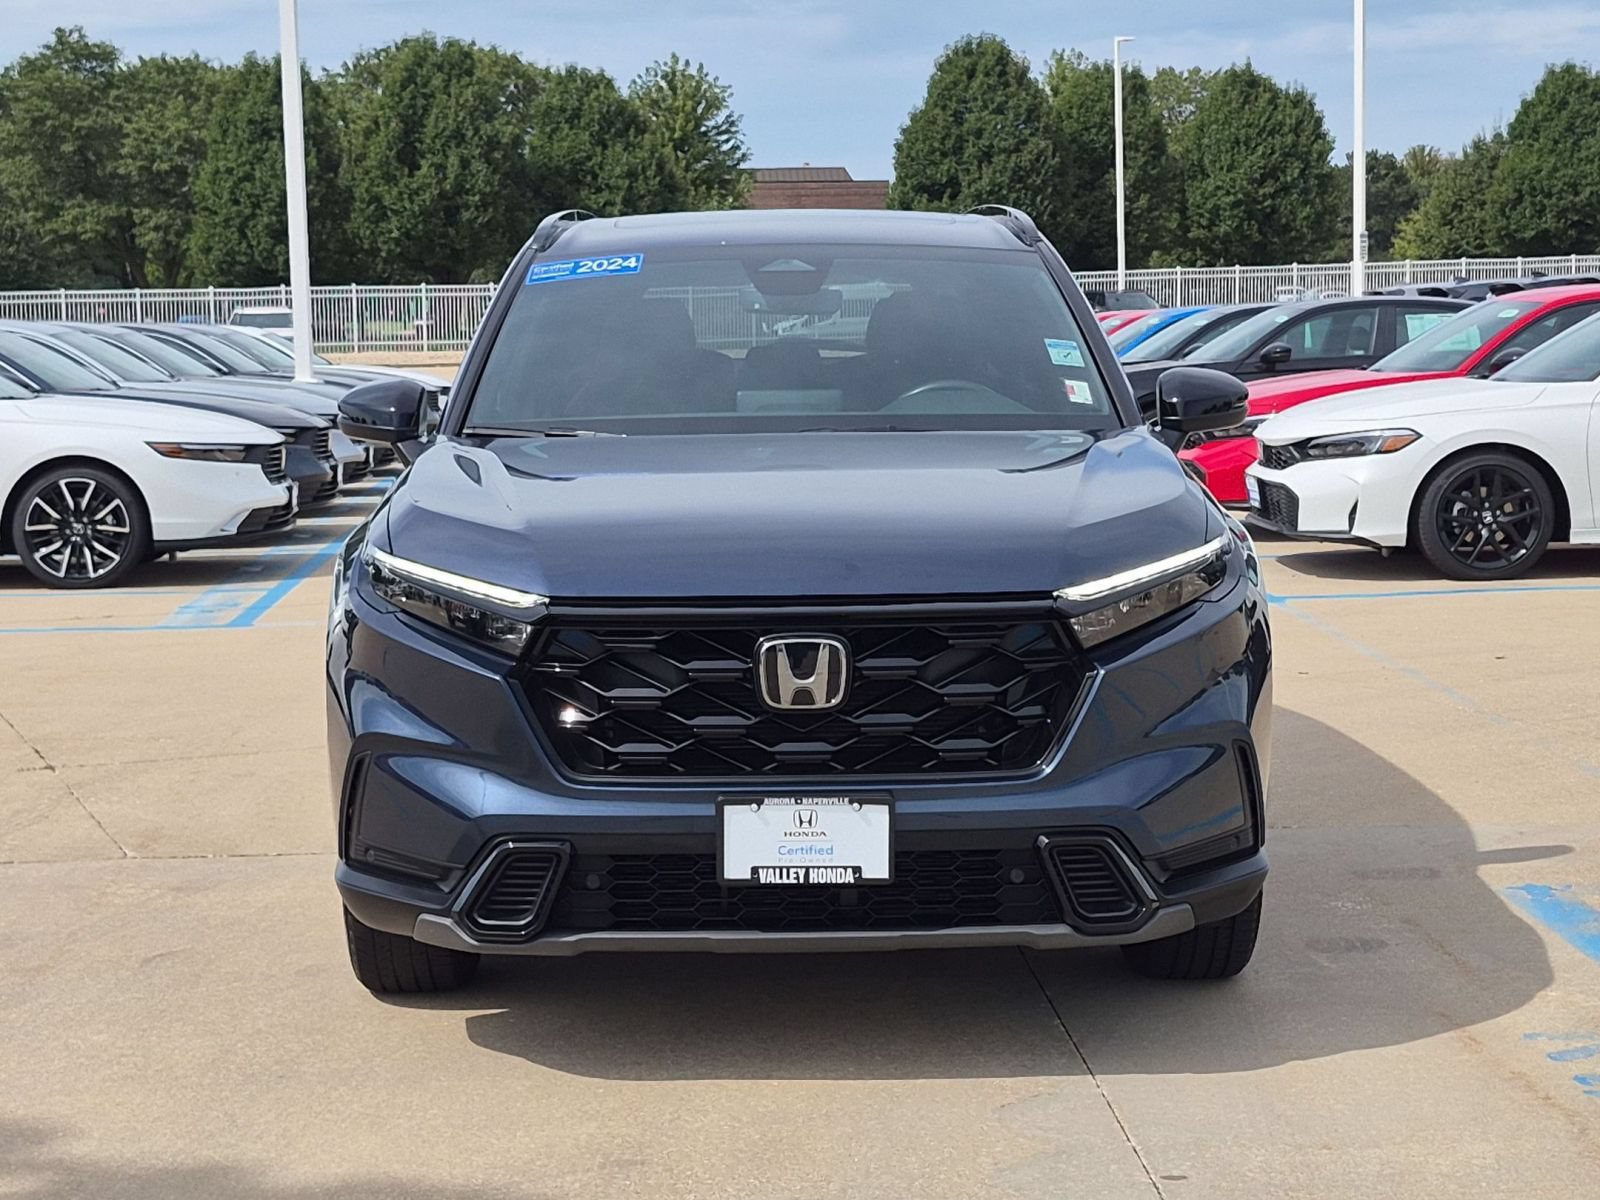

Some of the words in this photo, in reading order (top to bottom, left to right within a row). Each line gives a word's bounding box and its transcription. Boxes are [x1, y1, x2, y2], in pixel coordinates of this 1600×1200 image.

[575, 256, 638, 273] 2024
[763, 797, 796, 806] AURORA
[802, 797, 849, 806] NAPERVILLE
[777, 845, 833, 856] Certified
[758, 868, 806, 884] VALLEY
[808, 868, 854, 884] HONDA
